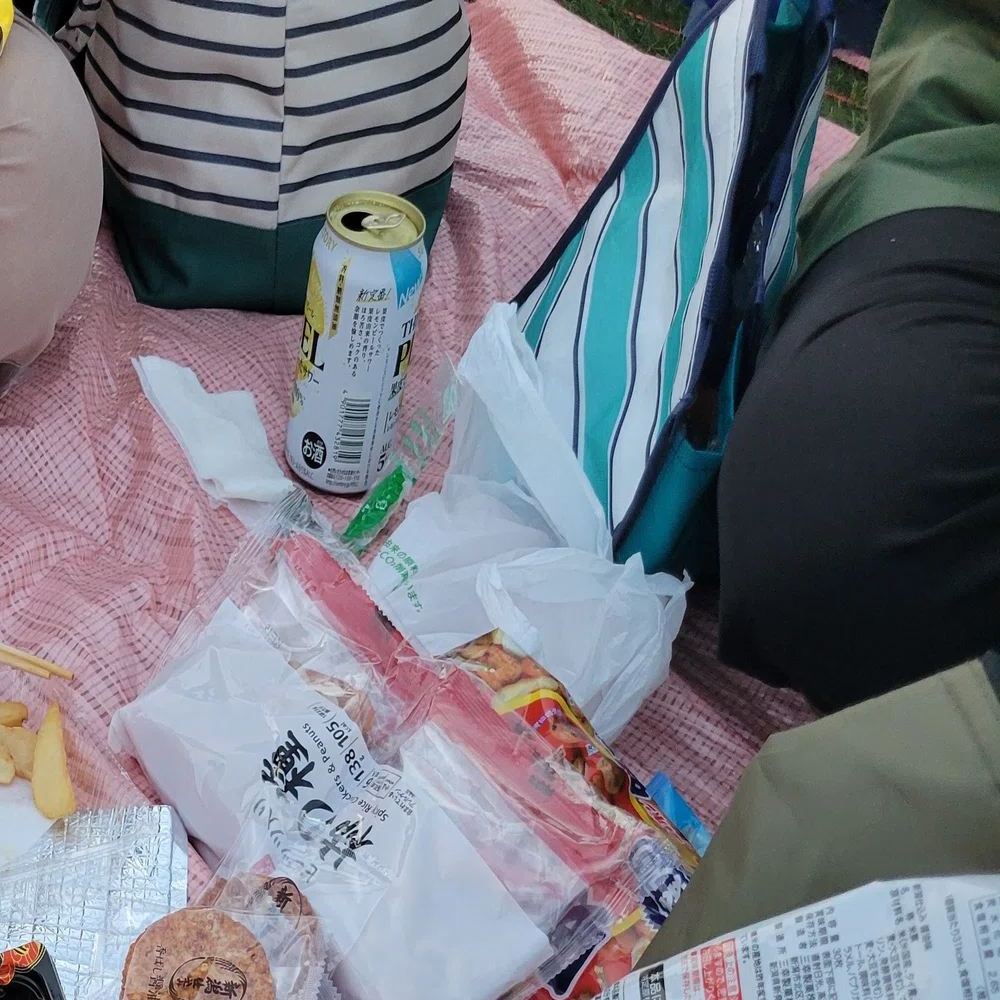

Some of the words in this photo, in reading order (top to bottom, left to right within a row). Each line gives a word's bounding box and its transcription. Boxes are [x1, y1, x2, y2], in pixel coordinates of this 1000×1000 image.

[302, 438, 325, 465] お酒
[302, 722, 331, 763] Peanuts
[325, 720, 346, 748] 105
[326, 763, 336, 775] &
[344, 748, 362, 783] 138
